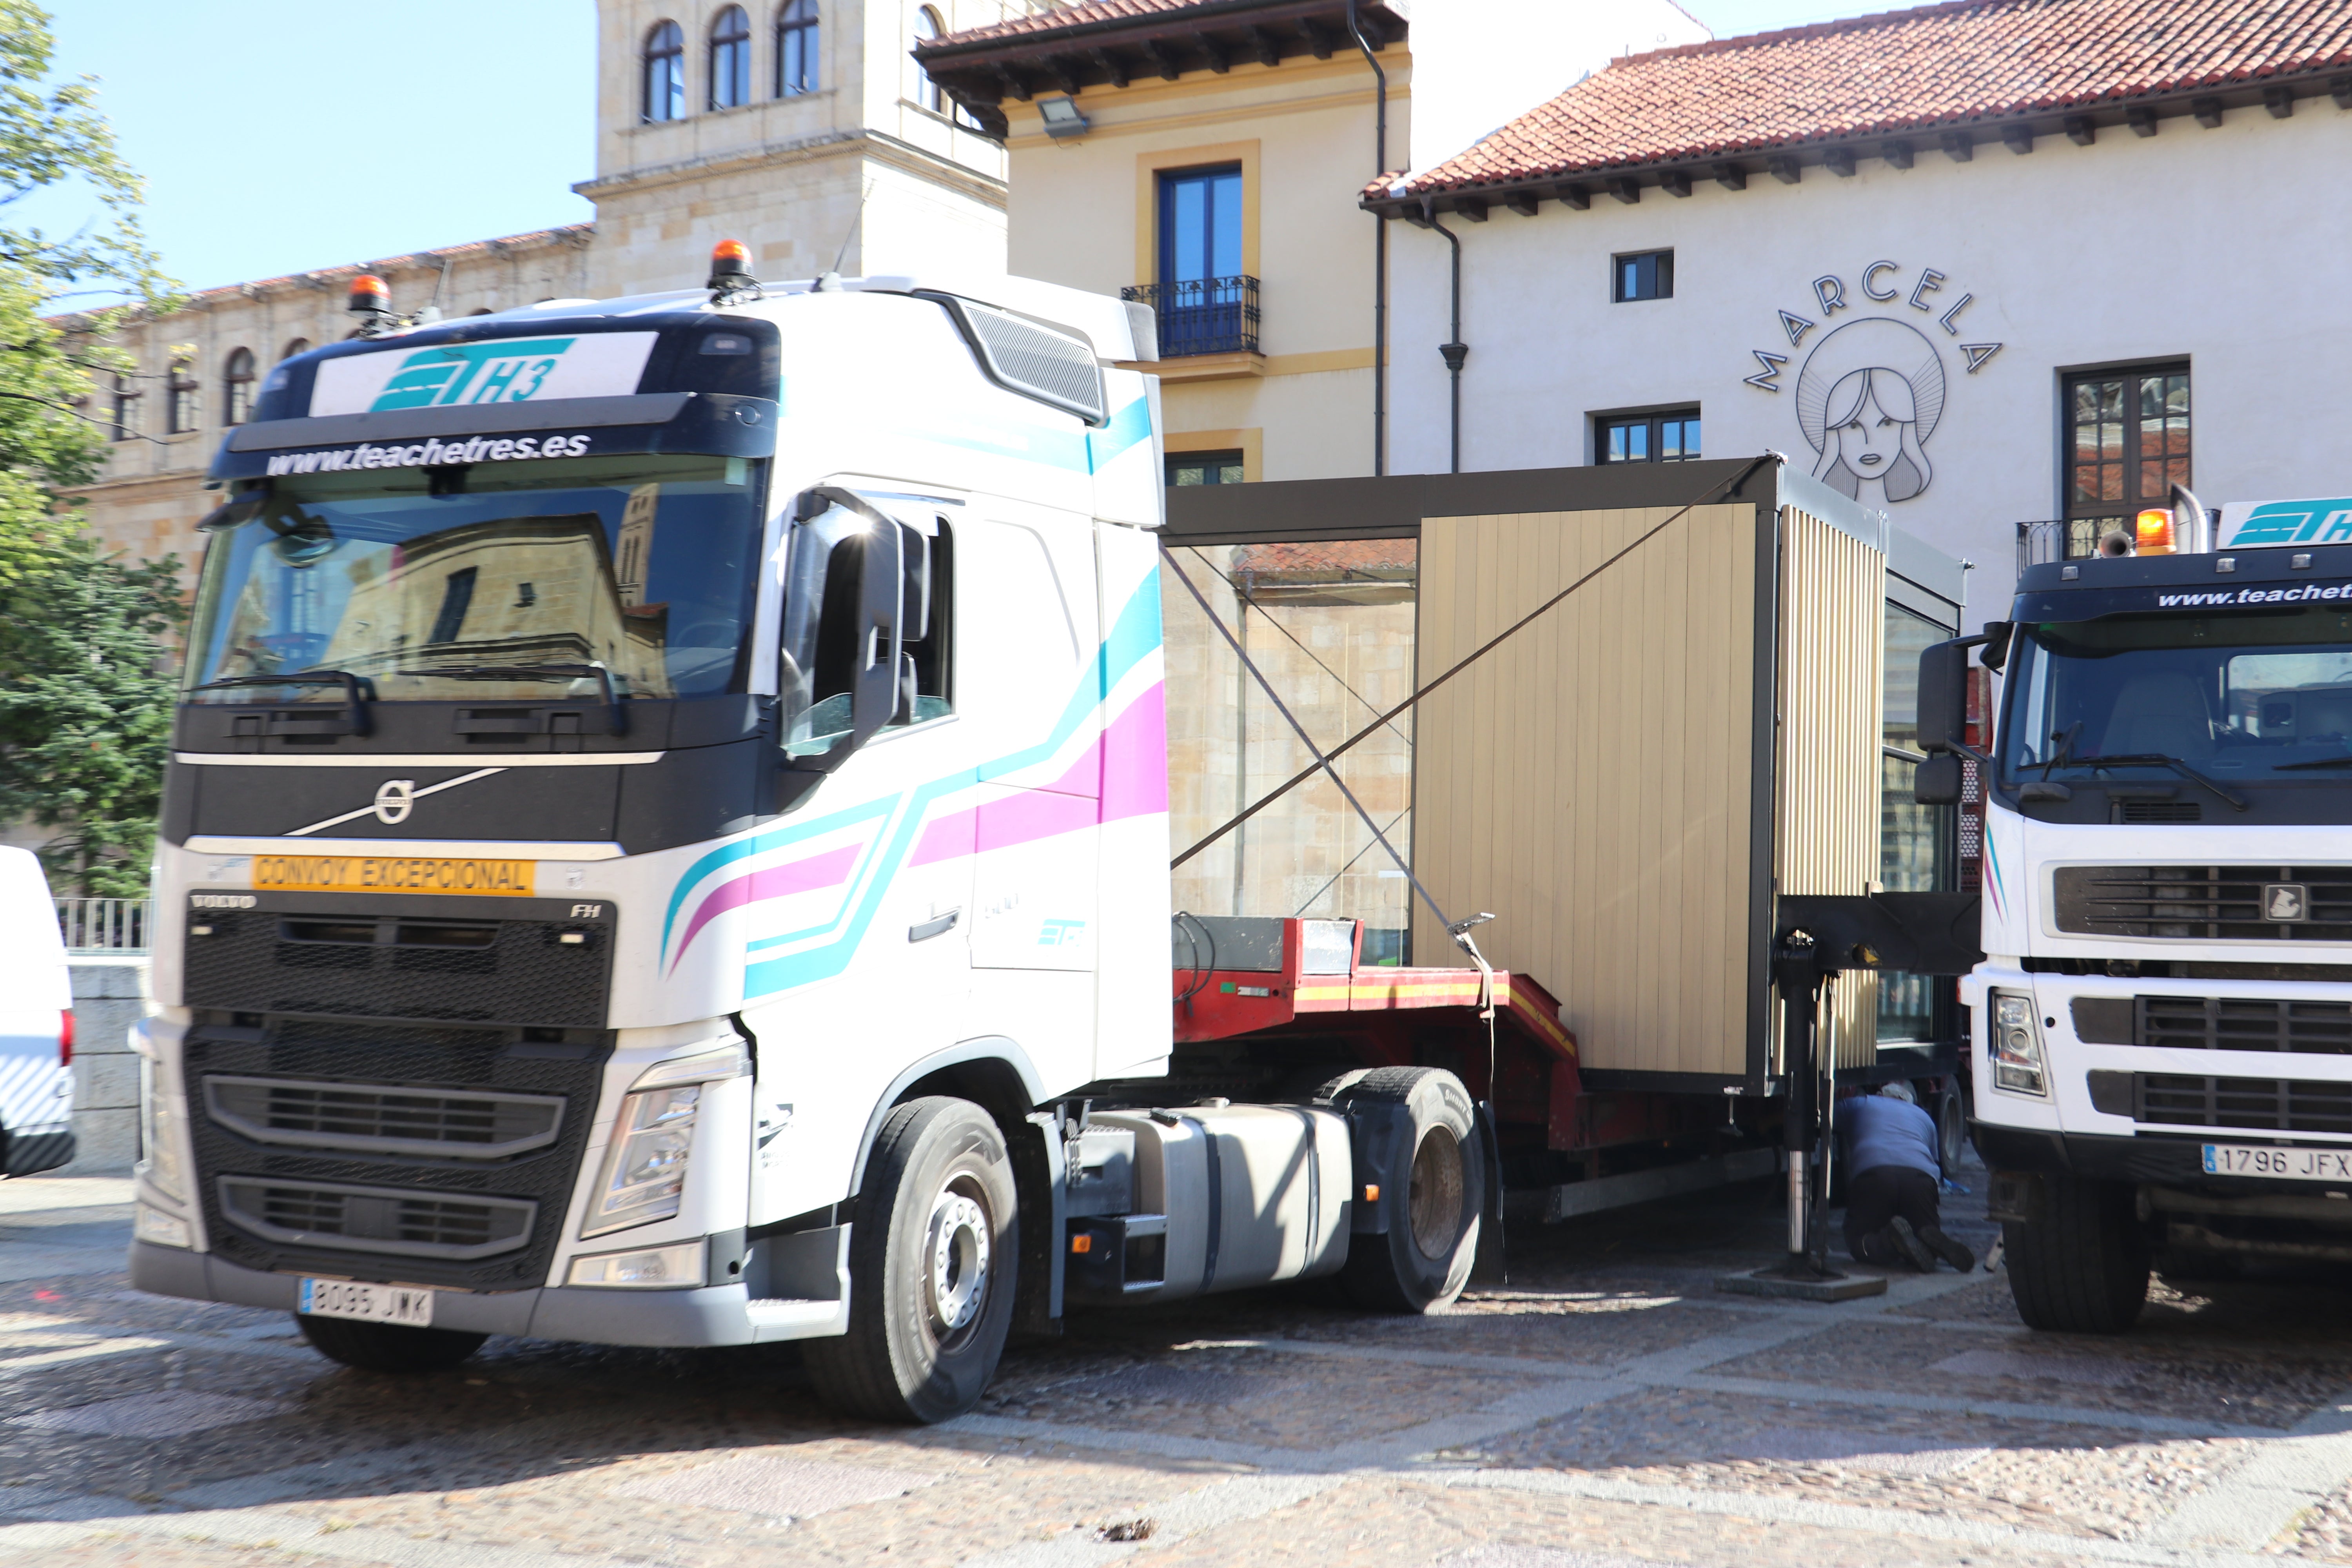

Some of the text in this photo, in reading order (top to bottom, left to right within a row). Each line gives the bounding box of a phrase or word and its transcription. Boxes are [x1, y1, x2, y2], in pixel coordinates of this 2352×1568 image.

[1743, 260, 2004, 392] MARCELA
[267, 434, 592, 476] www.teachetres.es
[2158, 583, 2352, 607] www.teachet
[256, 858, 526, 890] CONVOY EXCEPCIONAL
[190, 895, 258, 909] VOLVO
[570, 904, 602, 918] FH
[2223, 1148, 2352, 1177] 1796 JFX
[315, 1283, 373, 1313] 8095
